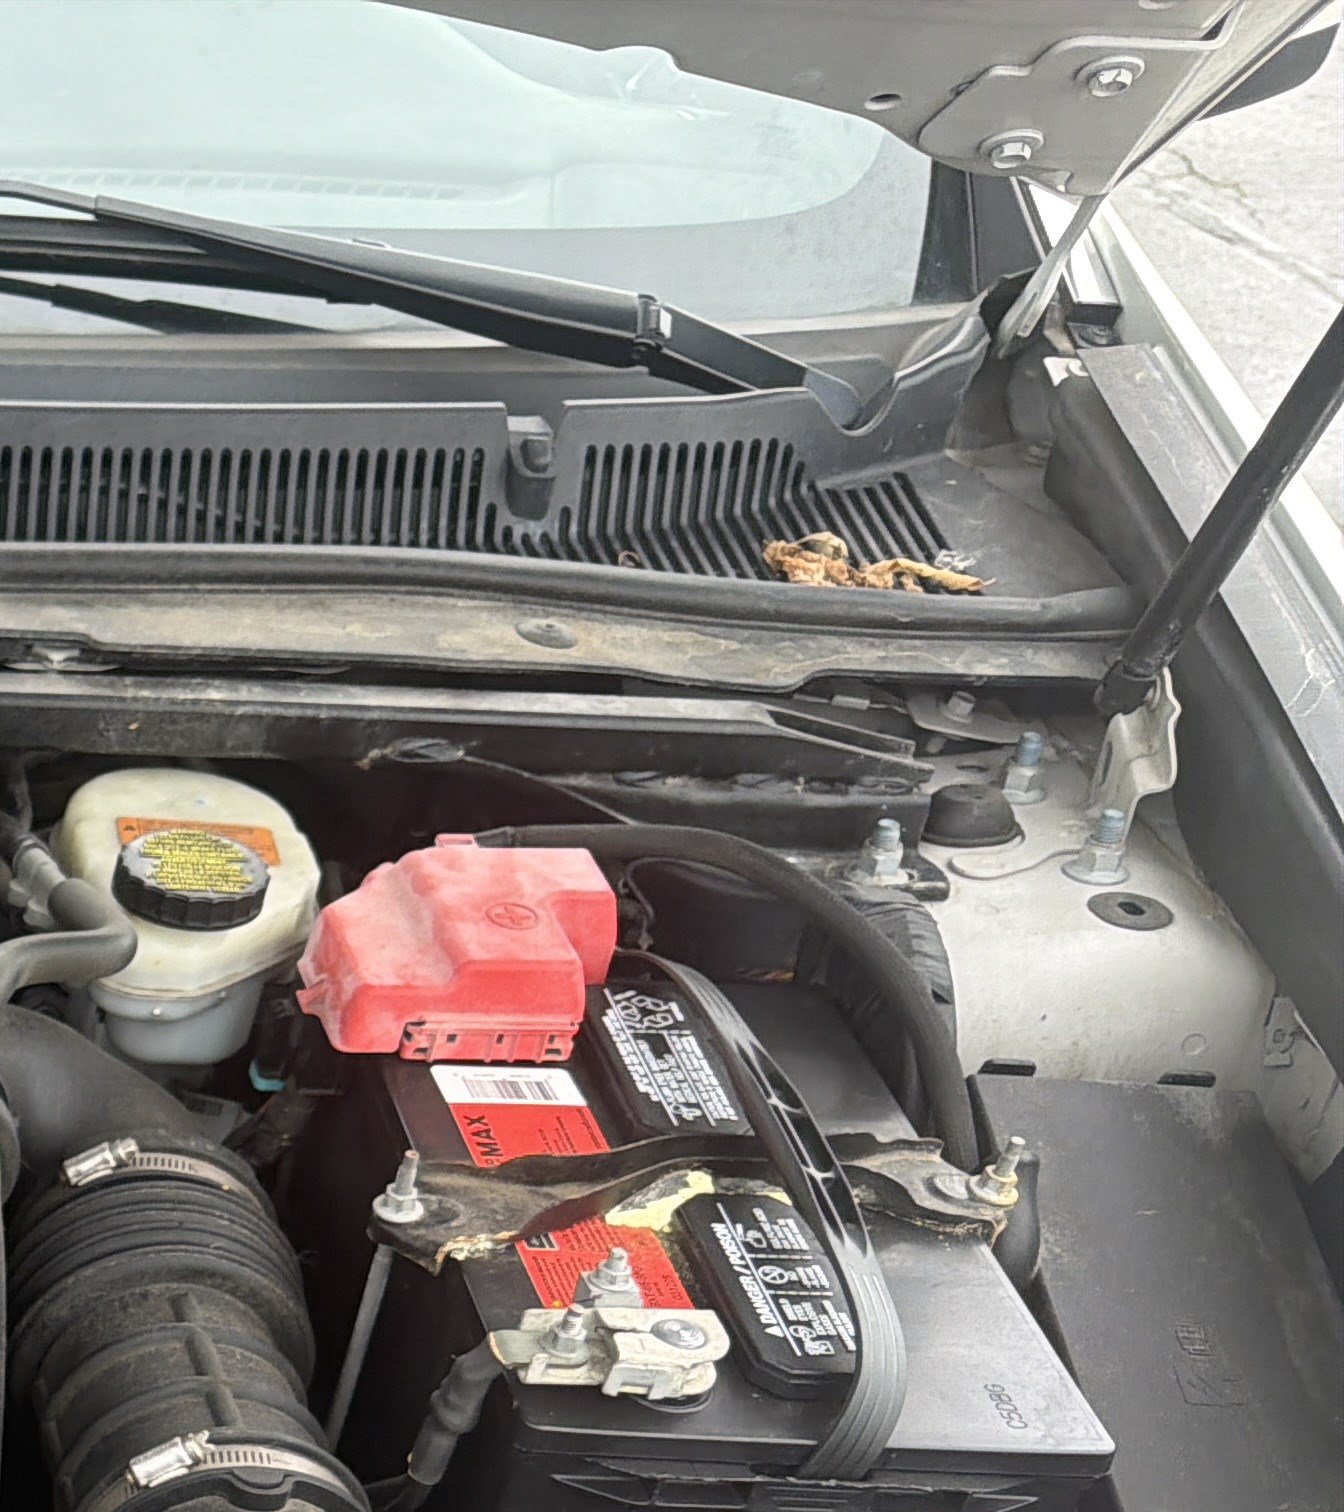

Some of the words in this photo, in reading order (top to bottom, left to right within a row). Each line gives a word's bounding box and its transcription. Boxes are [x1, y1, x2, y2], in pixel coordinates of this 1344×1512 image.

[463, 1115, 504, 1161] MAX
[710, 1222, 748, 1265] POISON
[739, 1275, 778, 1324] DANGER
